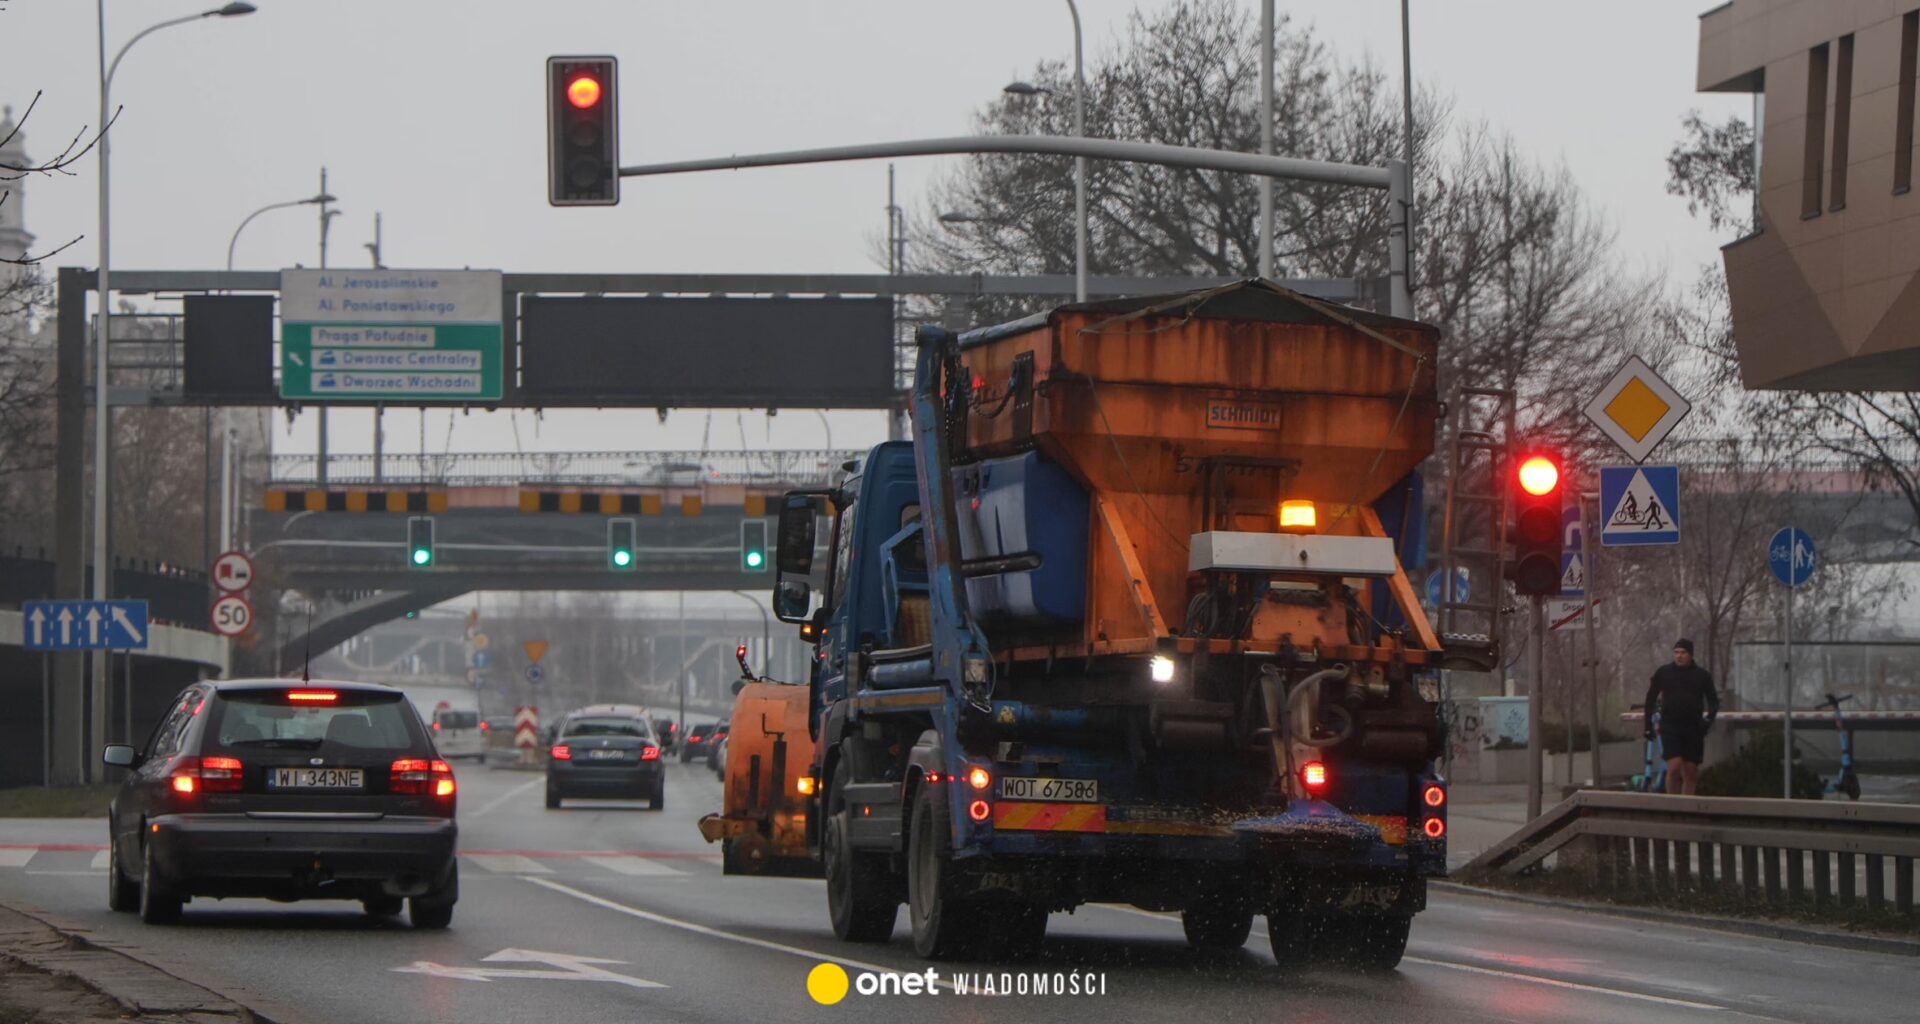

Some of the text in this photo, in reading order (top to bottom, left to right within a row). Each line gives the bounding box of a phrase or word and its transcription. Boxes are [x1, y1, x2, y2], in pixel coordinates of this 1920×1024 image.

[318, 276, 439, 289] Al. Jerozolimskie
[318, 298, 456, 315] Al. Poniatowskiego
[318, 330, 429, 343] Praga Południe
[343, 351, 477, 367] Dworzec Centralny
[343, 375, 476, 387] Dworzec Wschodni
[1211, 405, 1278, 424] SCHMIDT
[219, 604, 246, 625] 50
[280, 770, 360, 786] WI 343NE
[1004, 779, 1095, 799] WOT 67586
